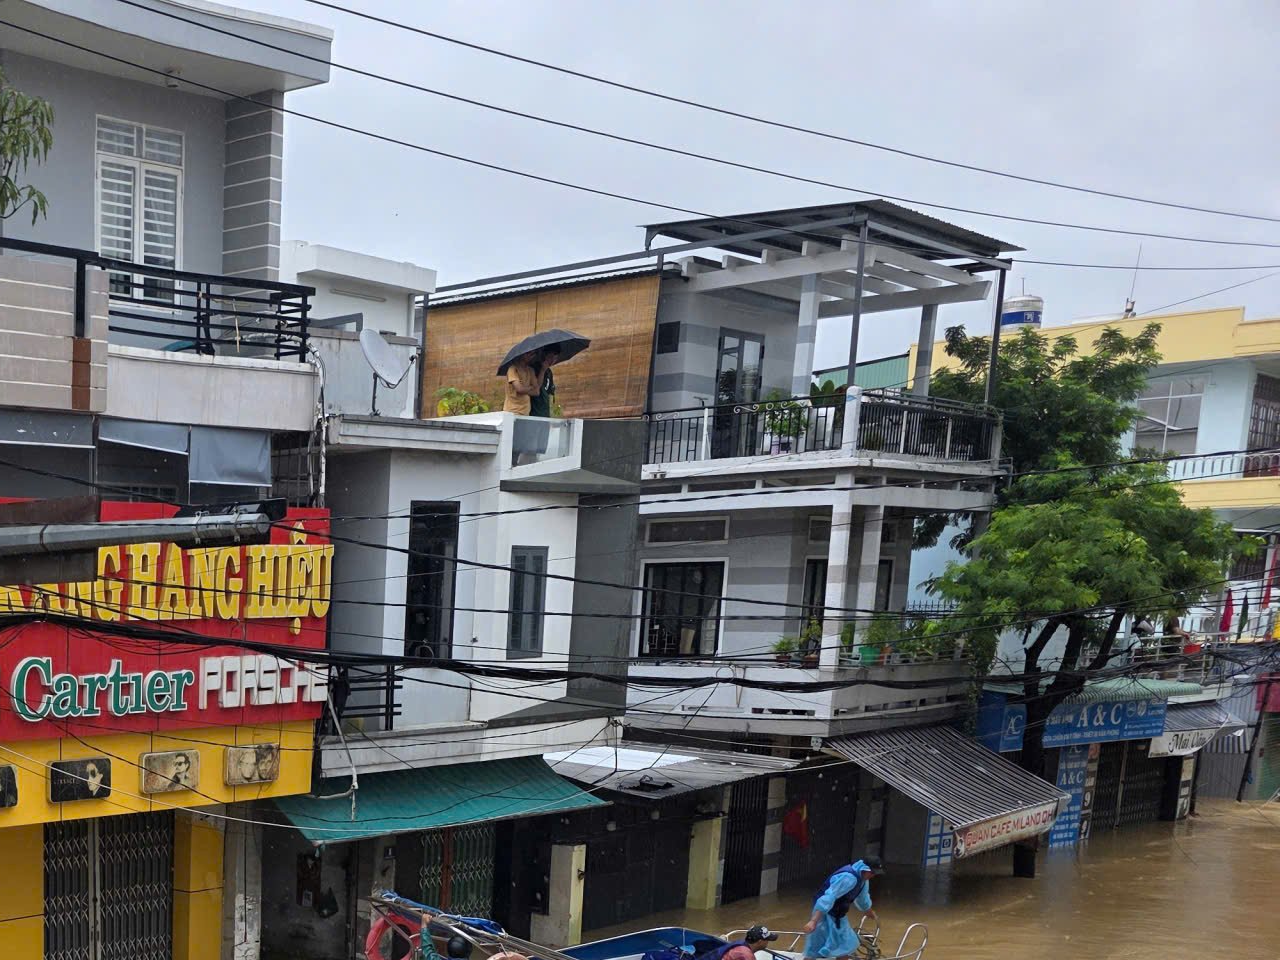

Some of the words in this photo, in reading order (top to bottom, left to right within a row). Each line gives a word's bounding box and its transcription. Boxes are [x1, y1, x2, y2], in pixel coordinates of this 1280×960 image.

[244, 522, 334, 635] HIỆU
[11, 656, 194, 721] Cartier
[199, 652, 328, 710] PORSCHE
